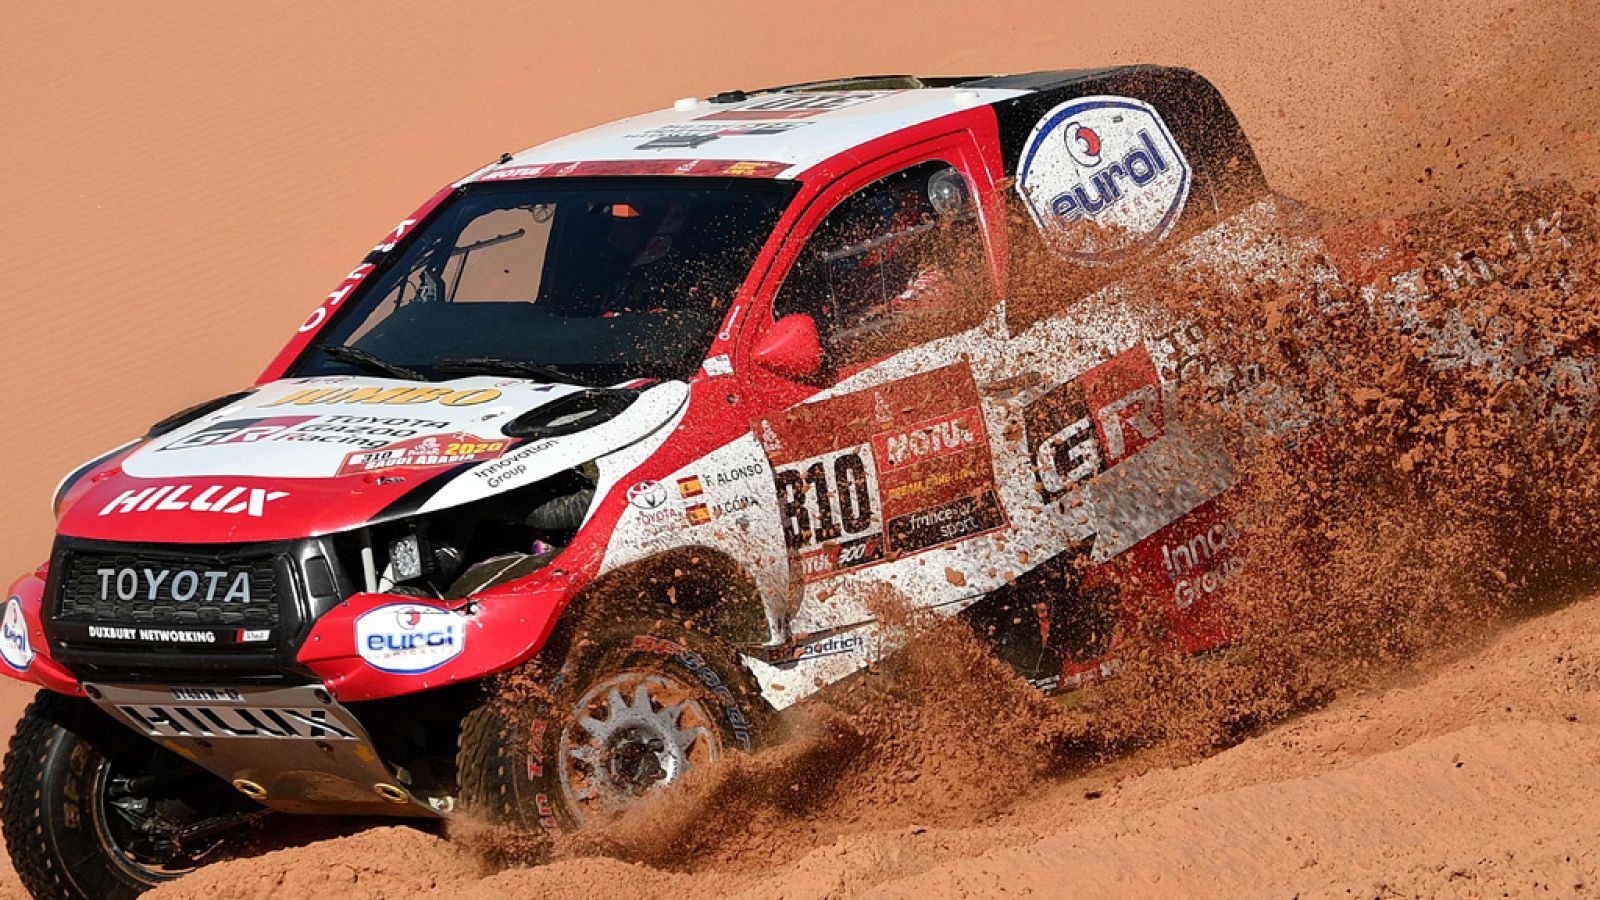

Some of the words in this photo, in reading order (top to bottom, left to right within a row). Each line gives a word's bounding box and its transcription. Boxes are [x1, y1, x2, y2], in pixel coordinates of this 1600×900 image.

[1051, 128, 1168, 230] eurol
[256, 386, 502, 408] JUMBO
[296, 424, 418, 438] GAZOO
[327, 414, 450, 430] TOYOTA
[273, 431, 391, 449] Racing
[444, 442, 504, 456] 2020
[365, 456, 412, 471] SAUDI
[415, 453, 476, 466] ARABIA
[473, 437, 561, 480] Innovation
[486, 463, 528, 489] Group
[716, 463, 763, 485] ALONSO
[97, 485, 291, 518] HILUX
[635, 507, 678, 526] TOYOTA
[97, 567, 251, 604] TOYOTA
[88, 625, 137, 640] DUXBURY
[139, 628, 216, 643] NETWORKING
[118, 706, 356, 739] HILUX
